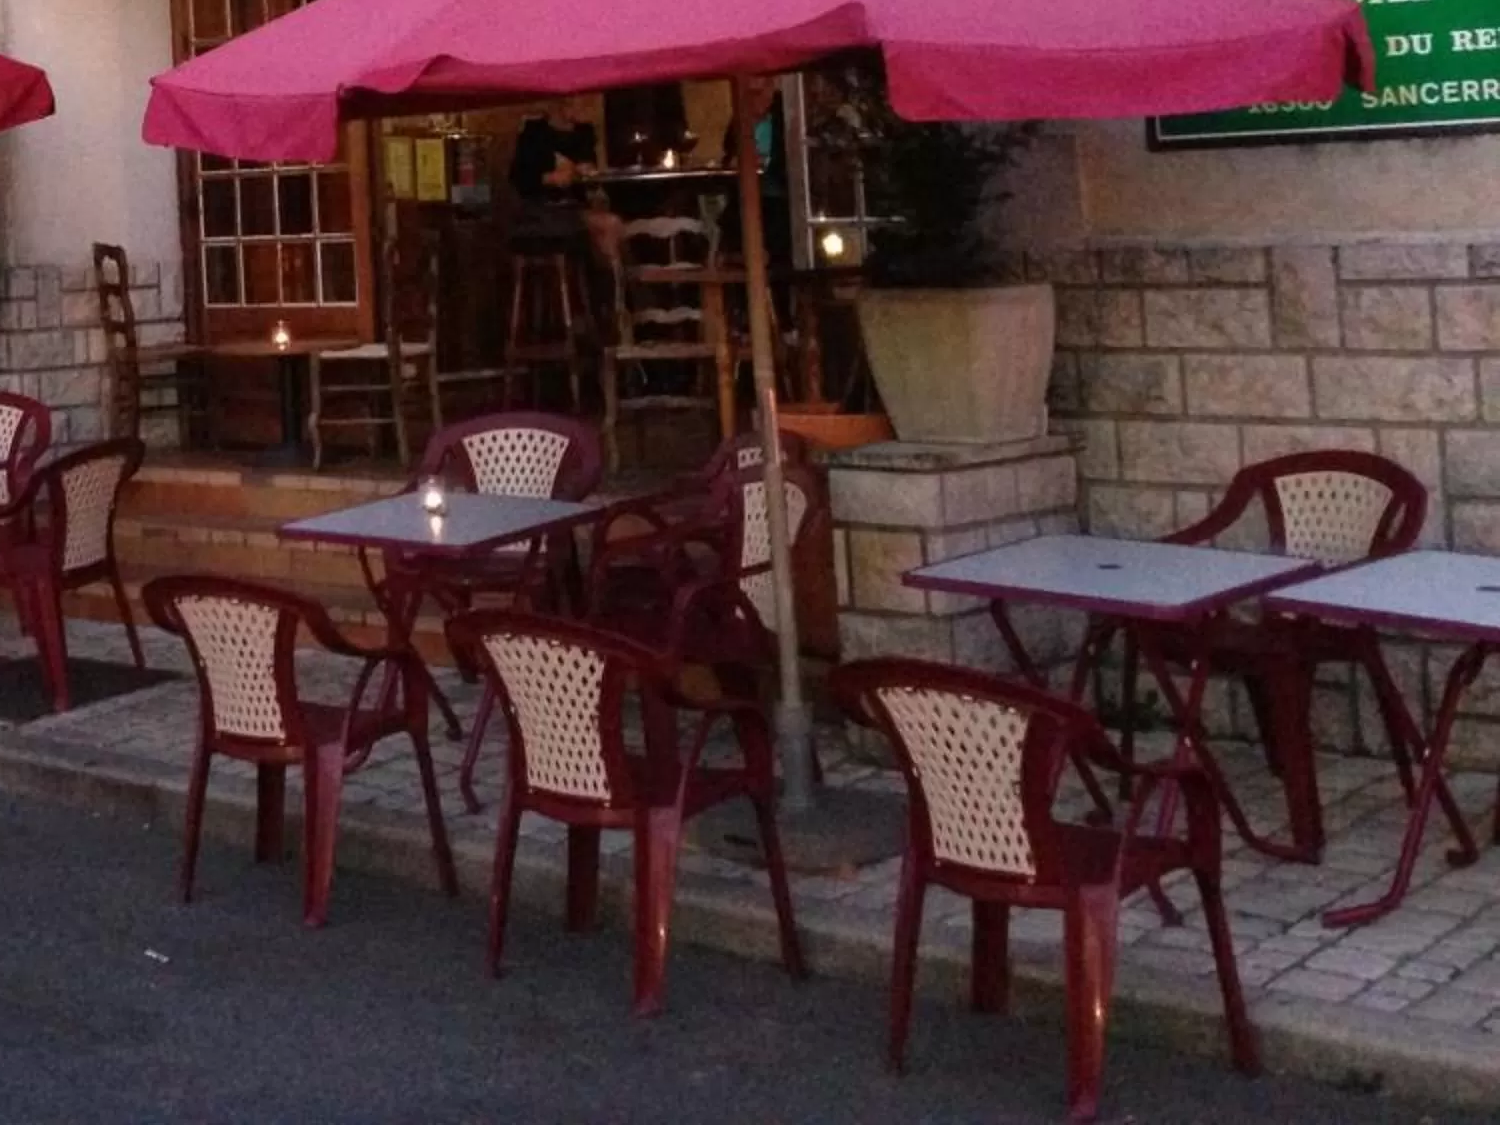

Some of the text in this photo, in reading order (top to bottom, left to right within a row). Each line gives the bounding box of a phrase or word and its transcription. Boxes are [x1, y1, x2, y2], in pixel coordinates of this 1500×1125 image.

[1385, 26, 1500, 56] DU RE
[1361, 78, 1500, 108] SANCERR
